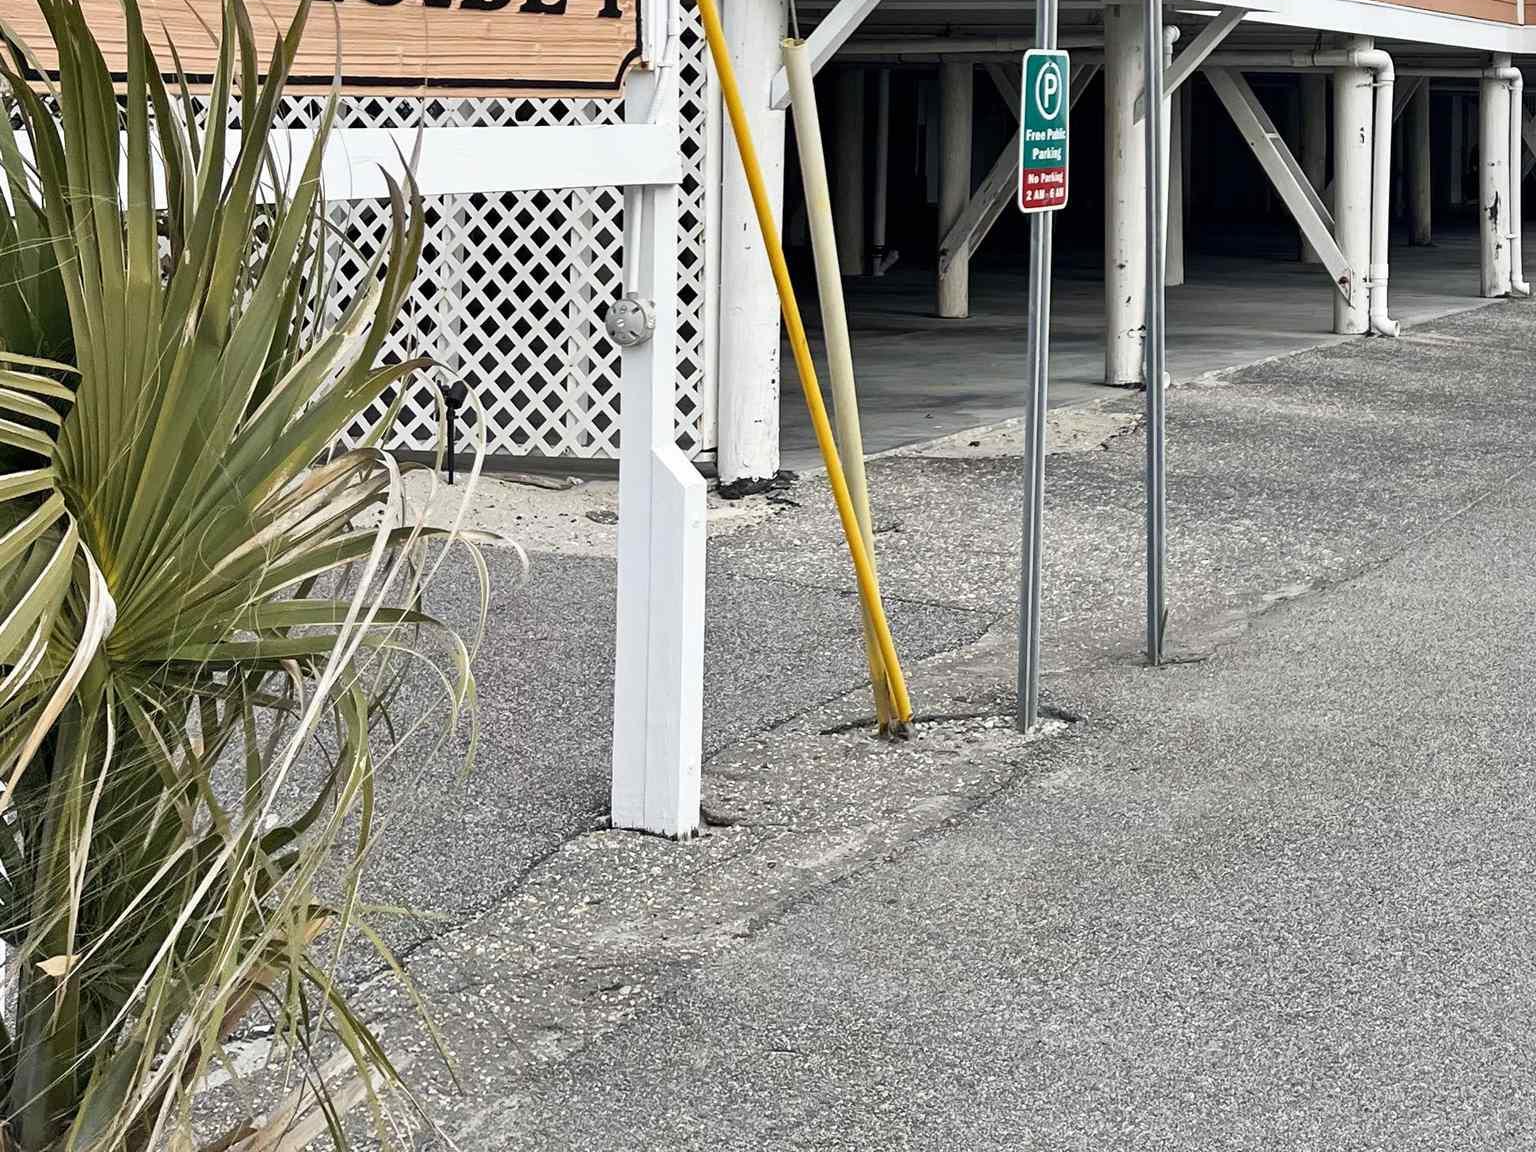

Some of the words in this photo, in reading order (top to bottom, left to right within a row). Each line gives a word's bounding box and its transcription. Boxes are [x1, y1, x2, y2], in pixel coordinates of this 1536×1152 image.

[1043, 72, 1058, 109] P
[1025, 129, 1046, 141] Free
[1032, 147, 1062, 160] Parking
[1027, 173, 1040, 184] No
[1040, 171, 1064, 184] Parking
[1025, 190, 1033, 201] 2
